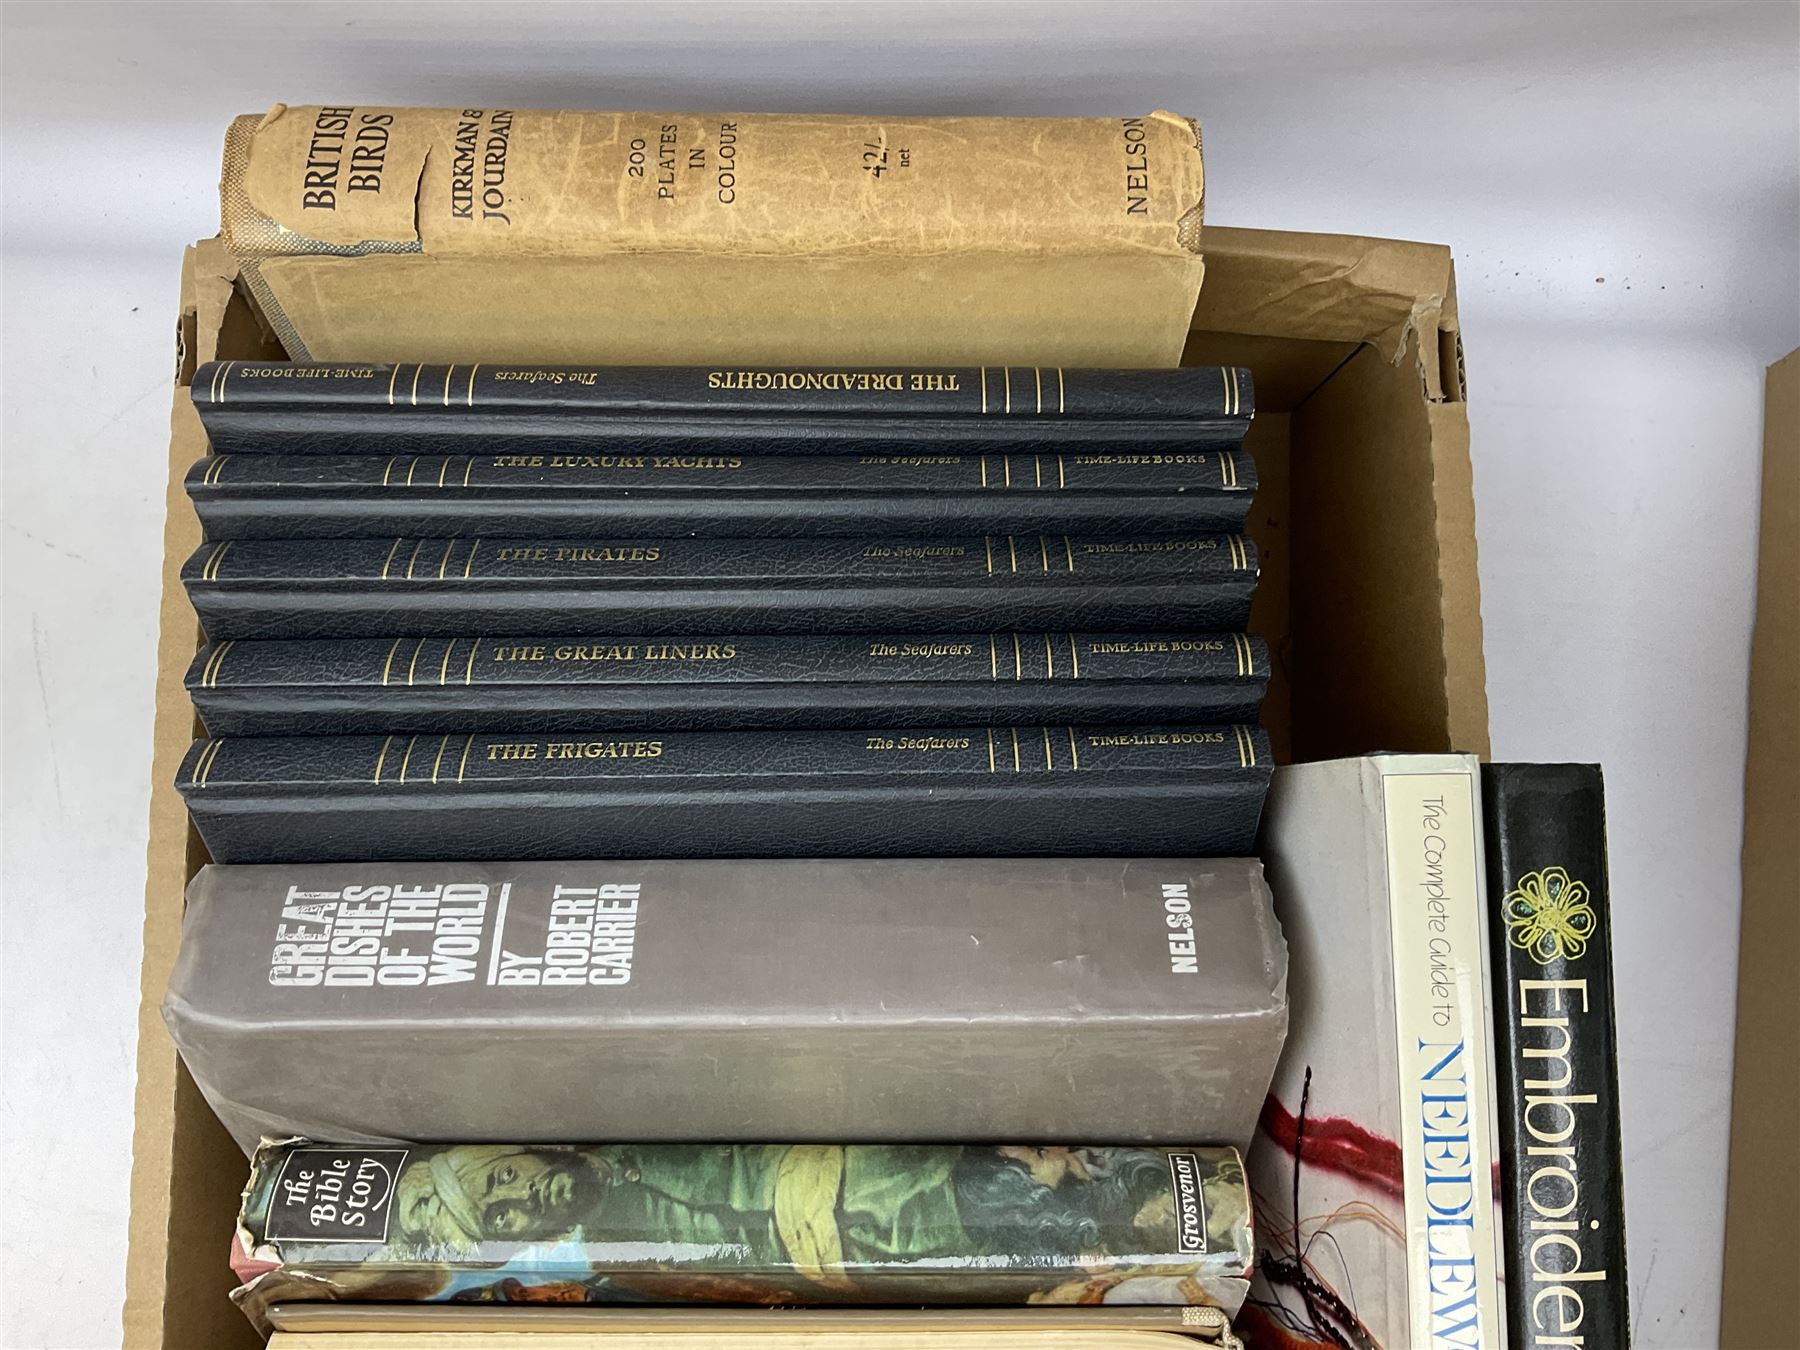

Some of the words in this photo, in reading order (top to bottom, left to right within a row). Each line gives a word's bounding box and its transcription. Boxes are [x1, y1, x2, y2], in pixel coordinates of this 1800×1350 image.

[462, 109, 484, 119] &
[303, 106, 355, 212] BRITISH
[347, 114, 394, 194] BIRDS
[452, 121, 481, 221] KIRKMAN
[483, 109, 514, 226] JOURDAIN
[629, 138, 646, 178] 200
[658, 124, 678, 200] PLATES
[689, 148, 706, 169] IN
[718, 122, 738, 204] COLOUR
[900, 148, 910, 168] net
[1122, 117, 1148, 215] NELSON
[241, 366, 295, 378] BOOKS
[298, 367, 373, 379] TIME-LIFE
[494, 370, 566, 385] Seafarers
[569, 371, 598, 385] The
[708, 371, 903, 391] DREADNOUGHTS
[911, 373, 960, 391] THE
[493, 456, 544, 467] THE
[550, 456, 647, 468] LUXURY
[652, 456, 742, 468] YACHTS
[1075, 455, 1150, 465] TIME-LIFE
[1153, 455, 1206, 464] BOOKS
[497, 548, 548, 561] THE
[554, 547, 660, 561] PIRATES
[863, 546, 889, 557] The
[892, 545, 965, 558] Seafarers
[1084, 542, 1161, 553] TIME-LIFE
[1163, 540, 1217, 551] BOOKS
[493, 646, 545, 661] THE
[554, 645, 637, 661] GREAT
[645, 644, 737, 660] LINERS
[870, 643, 899, 656] The
[902, 643, 972, 657] Seafarers
[1089, 642, 1169, 653] TIME-LIFE
[1172, 641, 1224, 652] BOOKS
[487, 743, 538, 760] THE
[546, 741, 663, 759] FRIGATES
[866, 737, 895, 750] The
[898, 736, 969, 750] Seafarers
[1089, 735, 1169, 746] TIME-LIFE
[1172, 733, 1224, 745] BOOKS
[1422, 794, 1447, 831] The
[1420, 835, 1450, 933] Complete
[384, 884, 443, 937] THE
[1162, 884, 1198, 973] NELSON
[269, 886, 341, 986] GREAT
[324, 885, 392, 986] DISHES
[427, 883, 490, 986] WORLD
[541, 884, 598, 985] ROBERT
[588, 883, 641, 986] CARRIER
[377, 946, 430, 986] OF
[498, 950, 542, 986] BY
[1429, 939, 1456, 998] Guide
[1433, 1003, 1454, 1027] to
[284, 1170, 315, 1206] The
[310, 1158, 351, 1227] Bible
[342, 1157, 391, 1227] Story
[1180, 1155, 1205, 1250] Grosvenor
[1418, 1037, 1480, 1350] NEEDLEW
